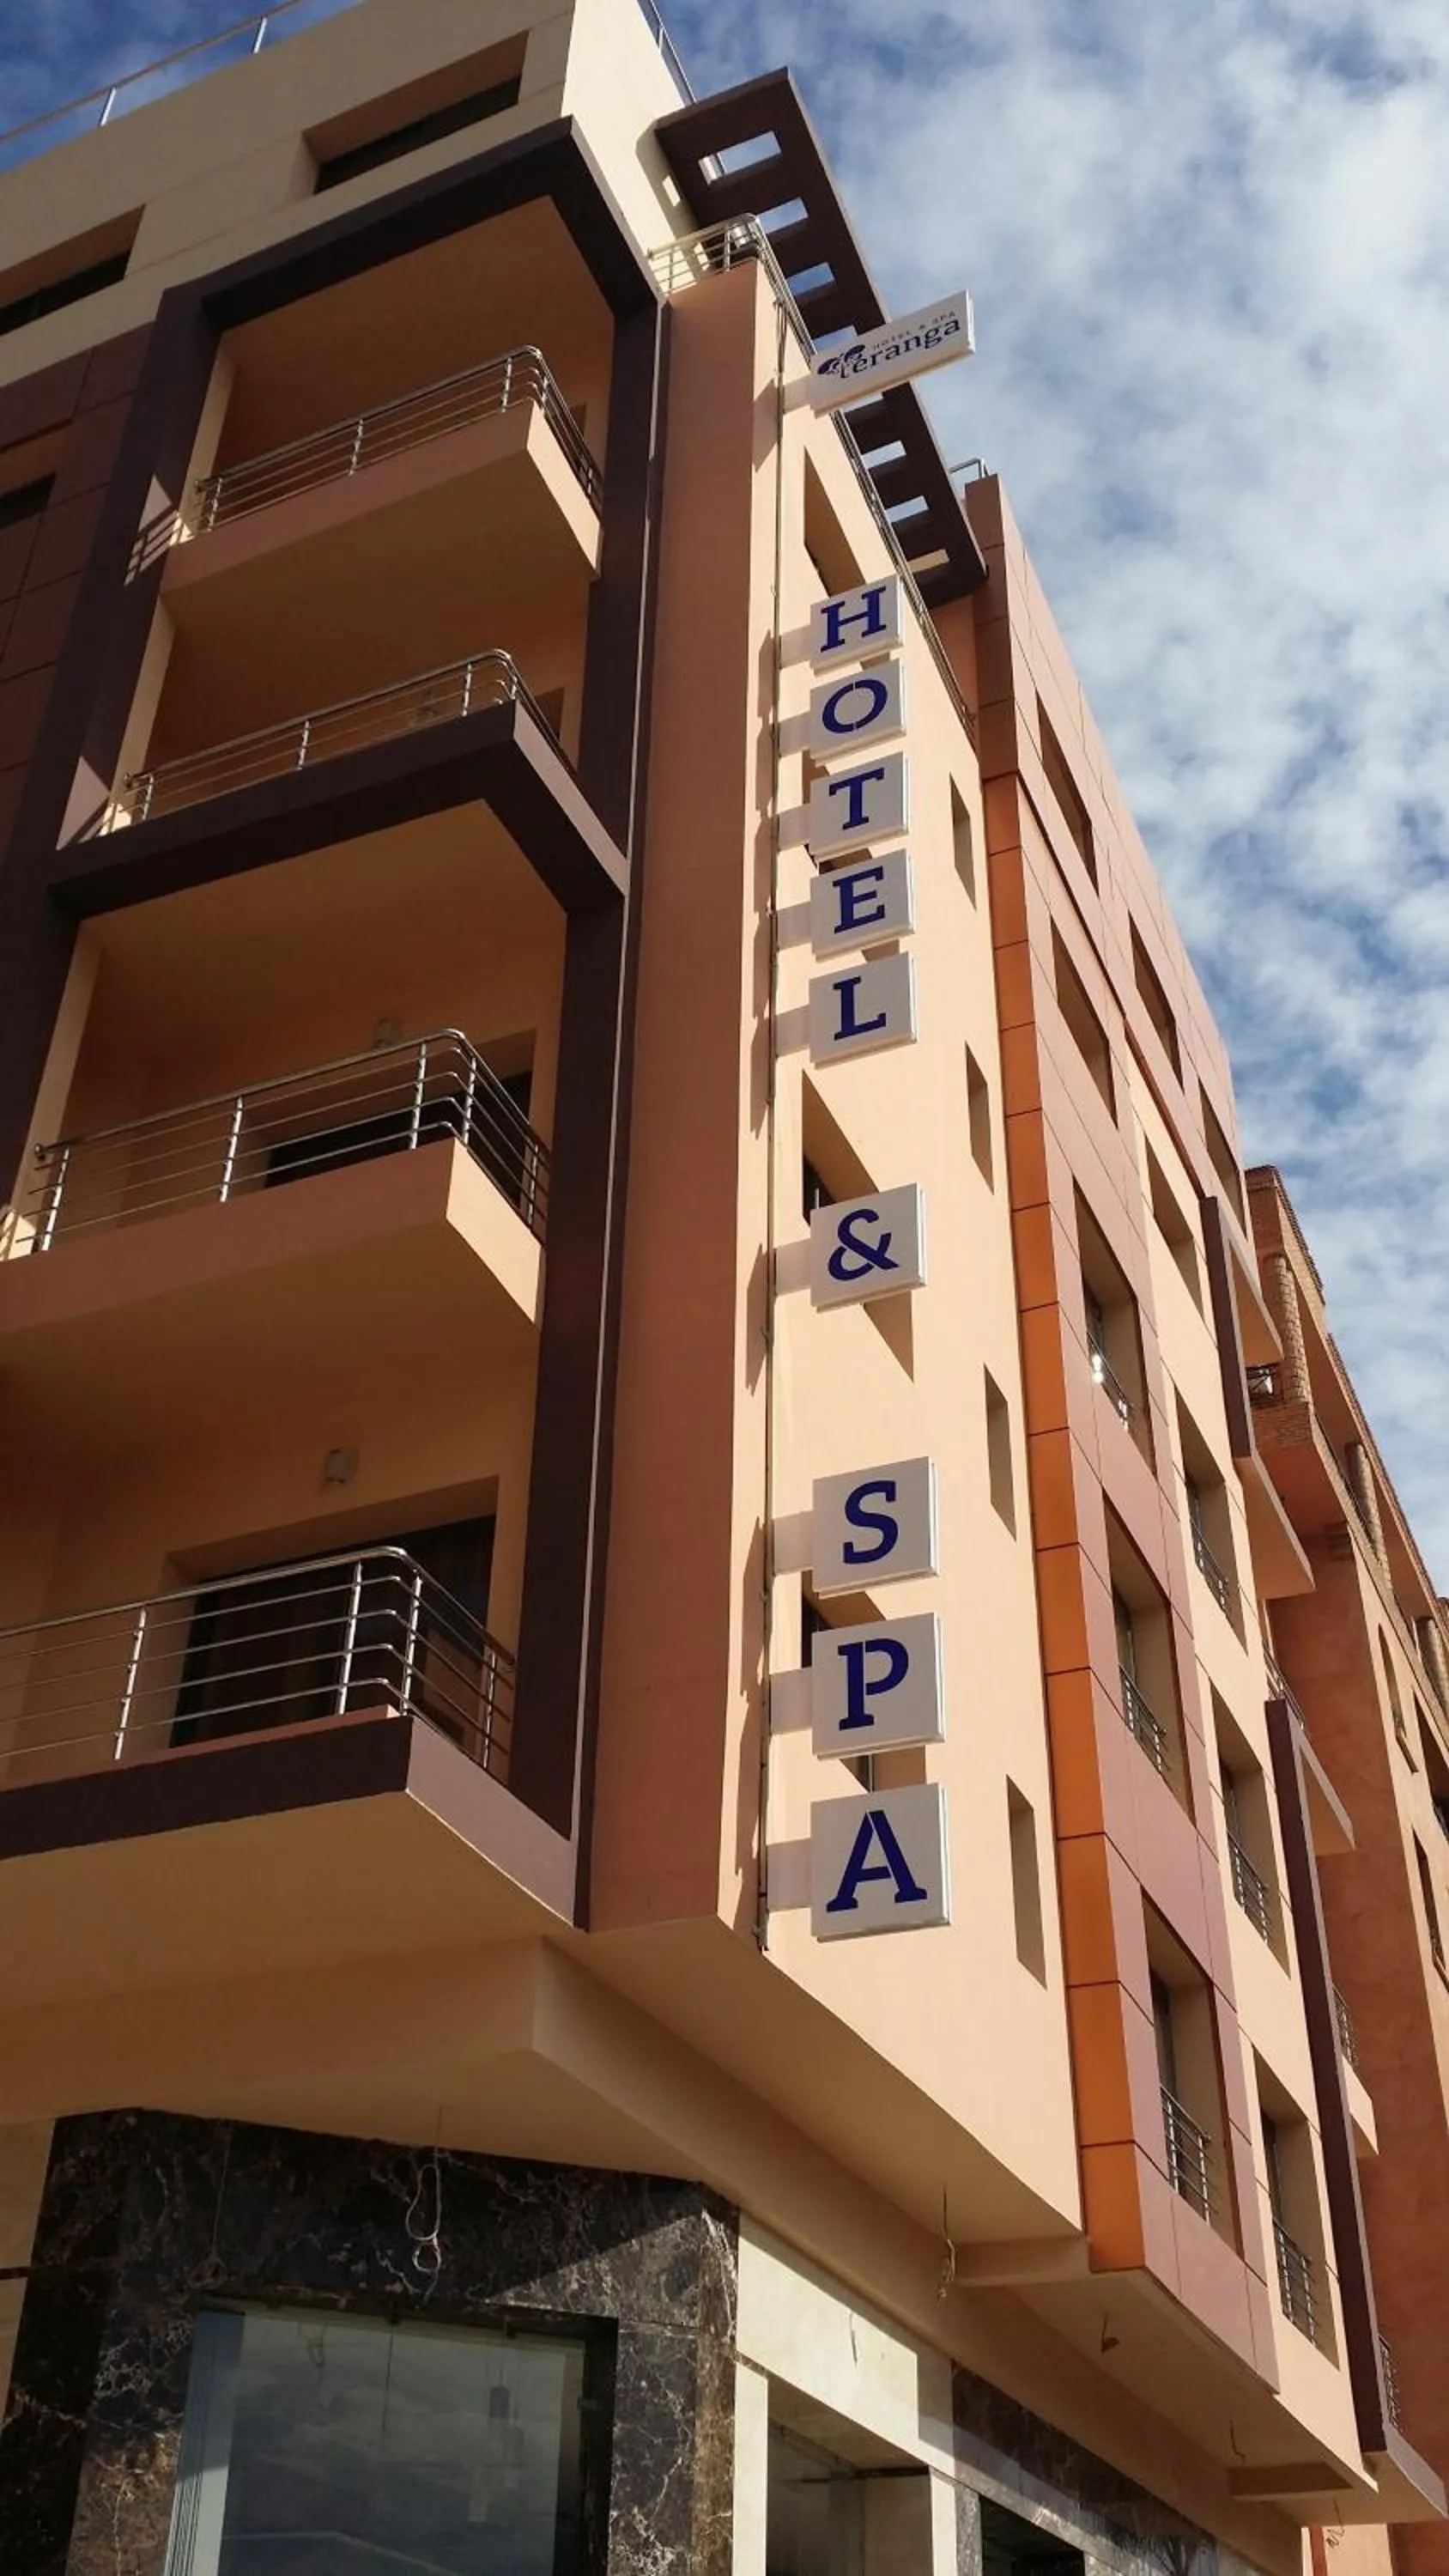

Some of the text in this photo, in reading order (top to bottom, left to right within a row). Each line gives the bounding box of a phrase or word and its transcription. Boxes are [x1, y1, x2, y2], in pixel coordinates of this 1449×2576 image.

[820, 586, 928, 1913] HOTEL & SPA
